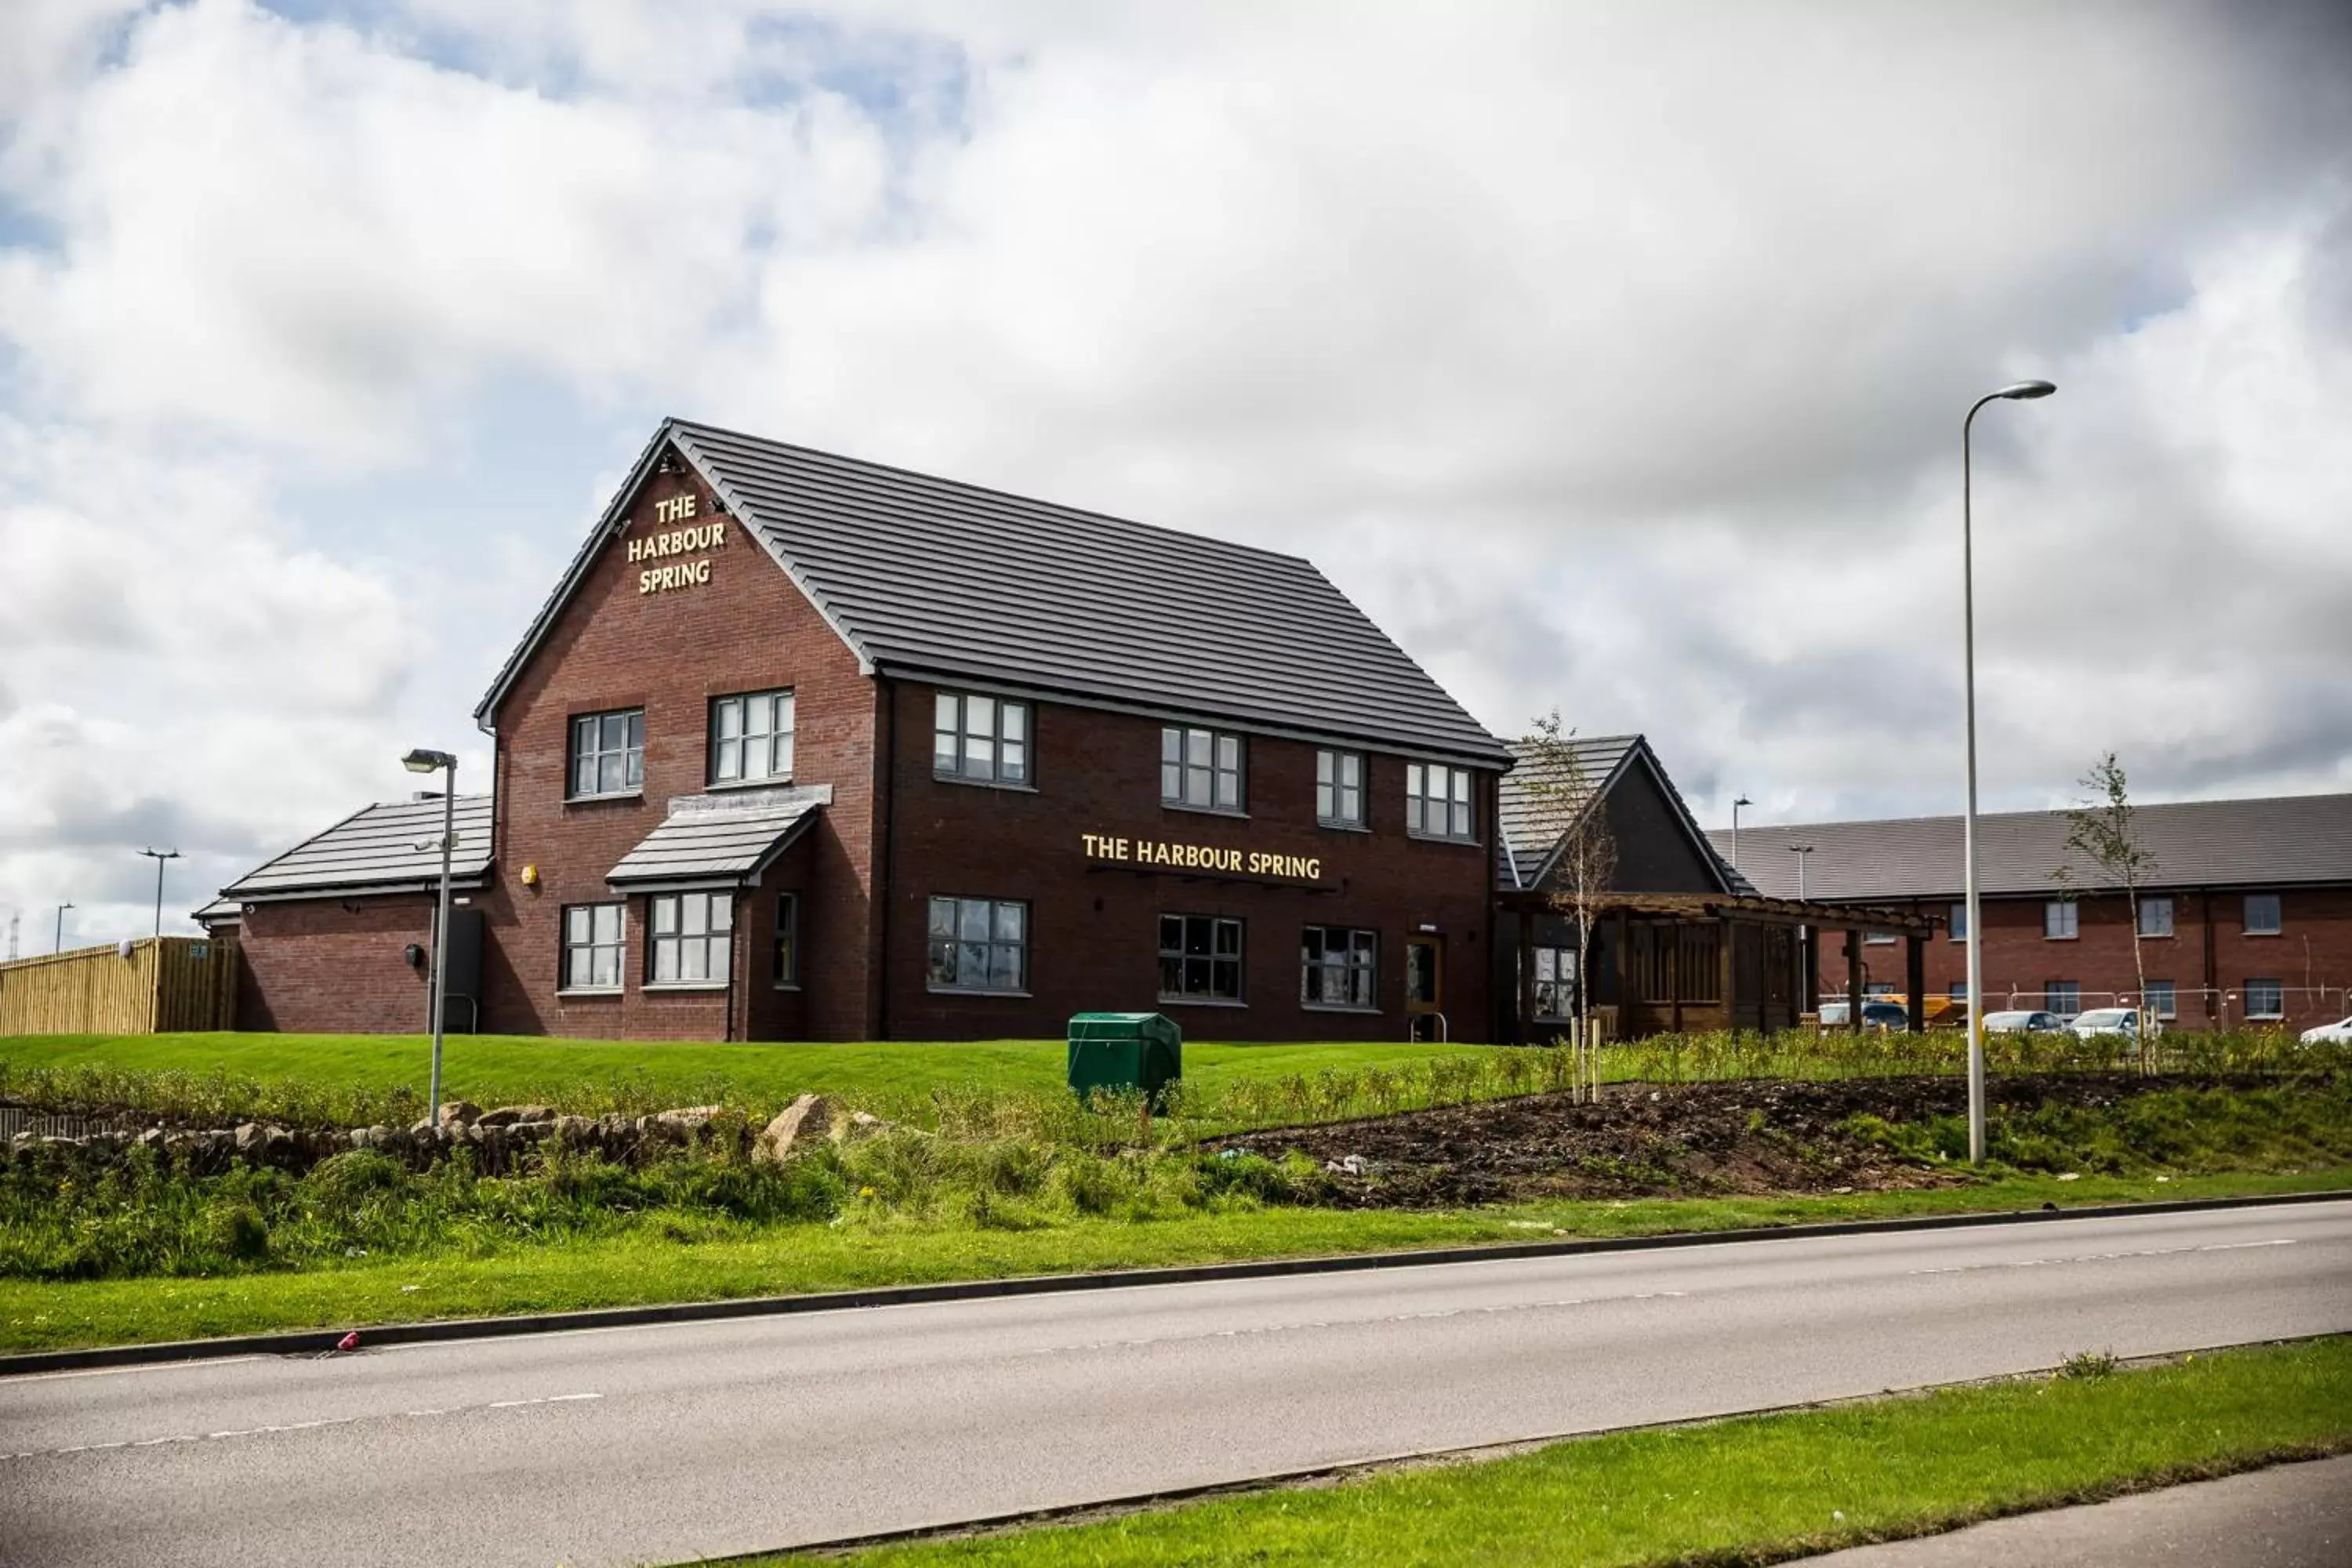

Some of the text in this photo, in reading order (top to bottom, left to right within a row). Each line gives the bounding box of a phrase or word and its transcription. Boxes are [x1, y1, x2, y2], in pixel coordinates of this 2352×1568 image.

[655, 495, 696, 523] THE
[628, 522, 724, 562] HARBOUR
[639, 559, 710, 593] SPRING
[1082, 834, 1320, 879] THE HARBOUR SPRING
